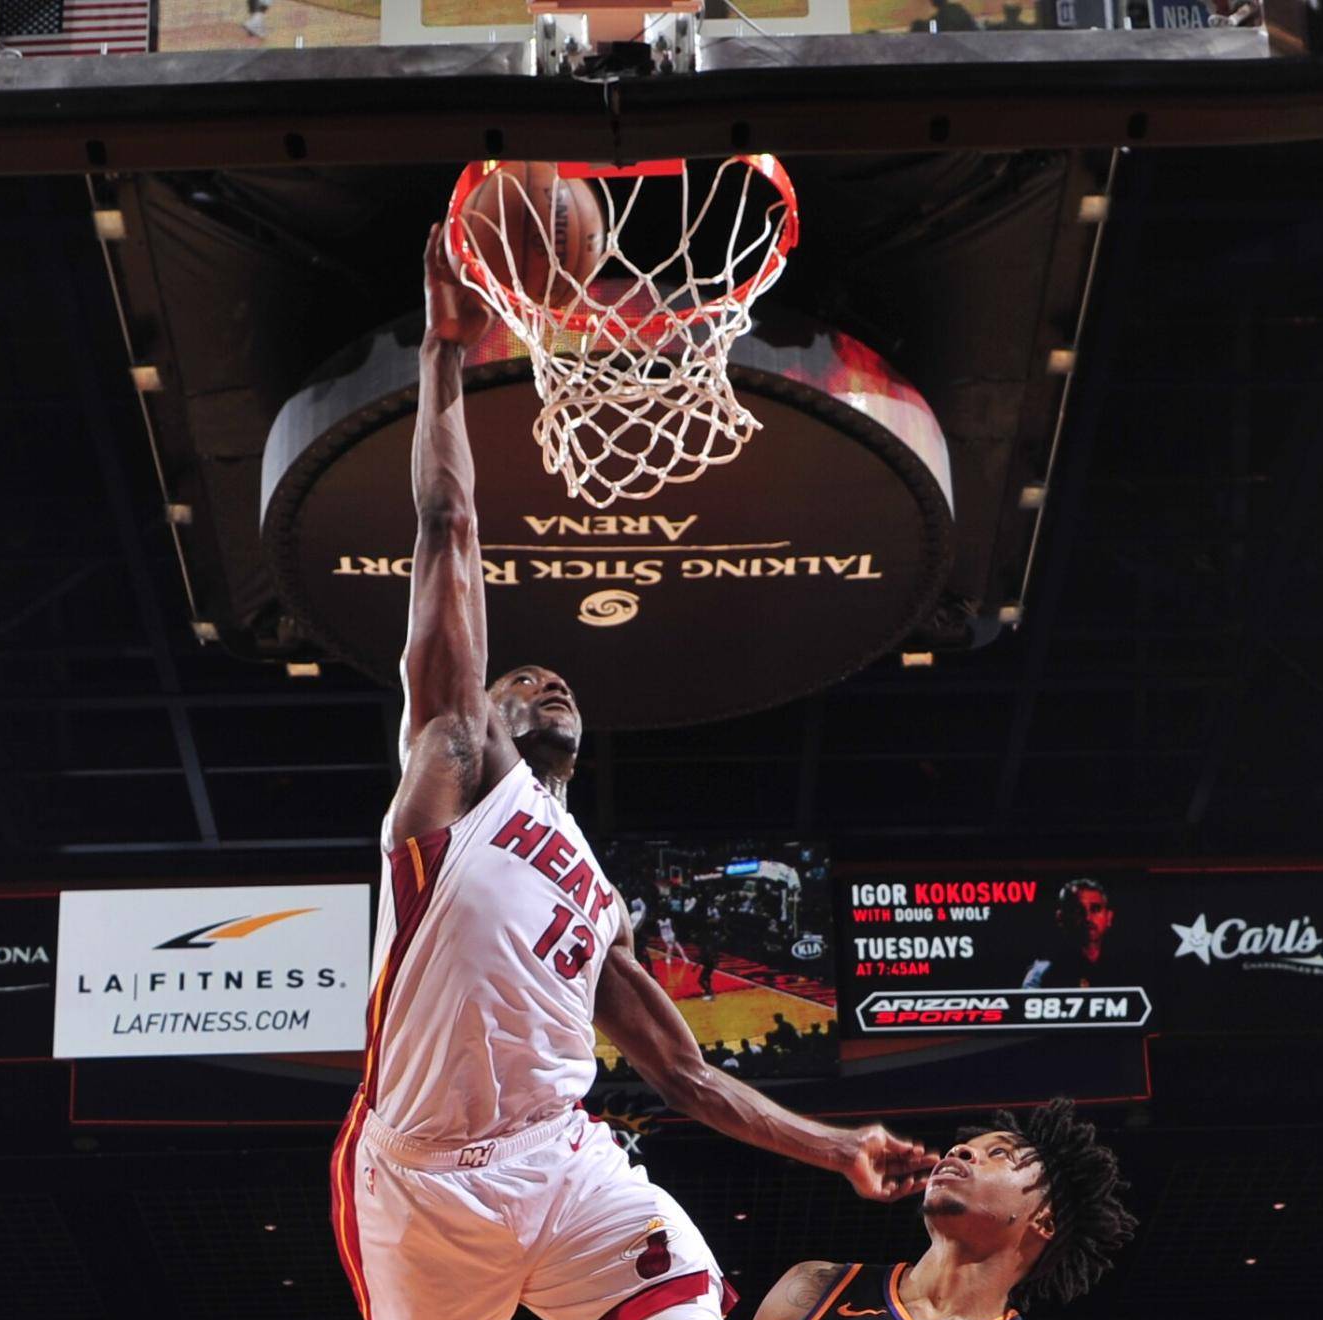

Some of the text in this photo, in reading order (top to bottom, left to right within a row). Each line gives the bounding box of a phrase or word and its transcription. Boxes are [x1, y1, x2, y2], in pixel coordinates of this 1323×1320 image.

[523, 514, 698, 542] ARENA
[333, 553, 882, 585] TALKING STICK RORT
[490, 809, 615, 928] HEAT
[851, 881, 1038, 907] IGOR KOKOSKOV
[852, 906, 991, 922] WITH DOUG & WOLF
[533, 904, 595, 981] 13
[854, 935, 974, 960] TUESDAYS
[1210, 915, 1323, 960] Carl's
[855, 962, 930, 976] AT 7:45AM
[868, 997, 1011, 1013] ARIZONA
[873, 1010, 1004, 1025] SPORTS
[1023, 997, 1128, 1020] 98.7 FM
[112, 1010, 310, 1036] LAFITNESS.COM
